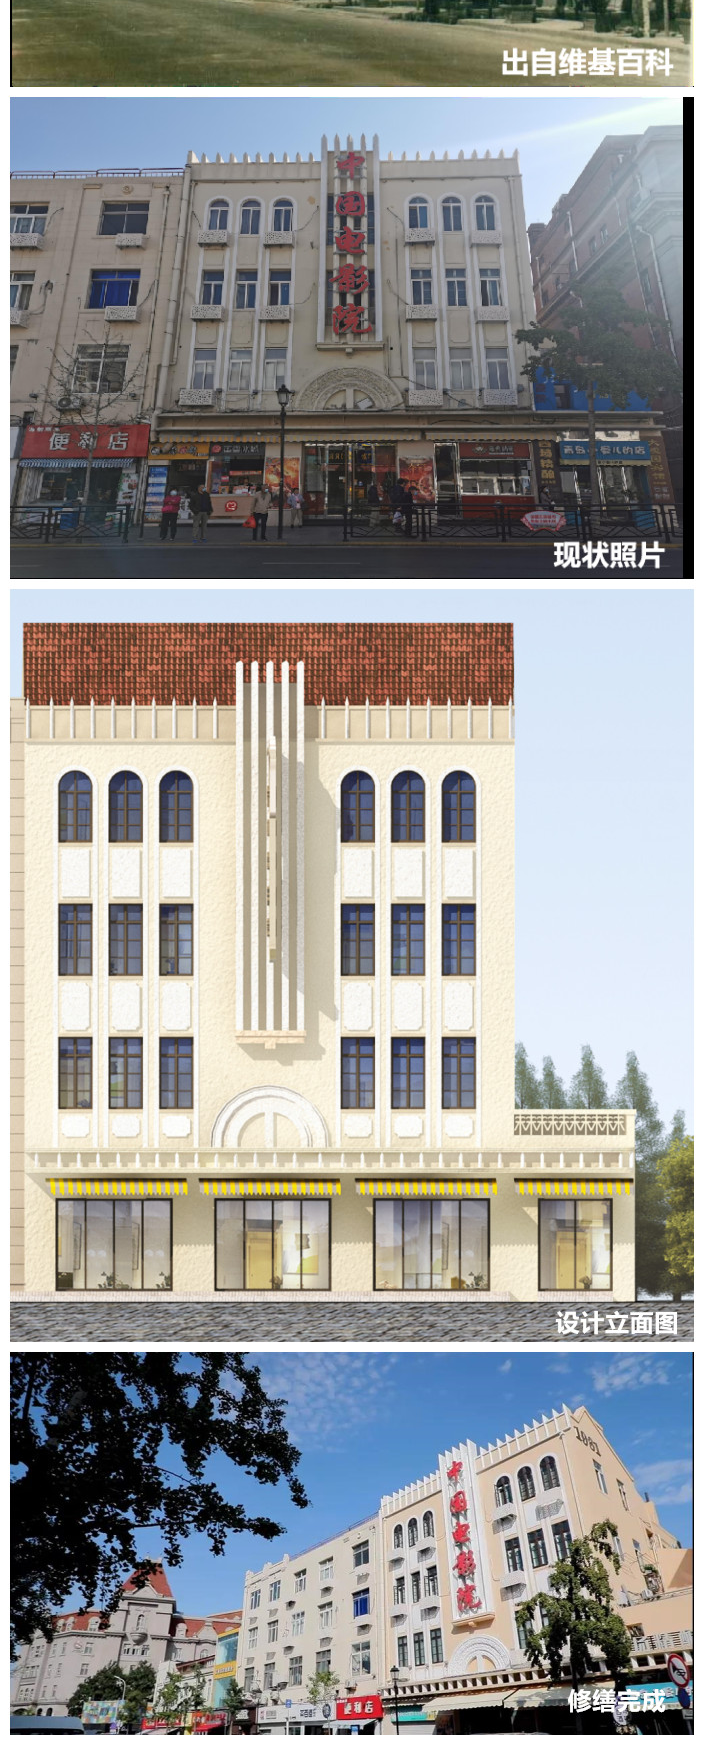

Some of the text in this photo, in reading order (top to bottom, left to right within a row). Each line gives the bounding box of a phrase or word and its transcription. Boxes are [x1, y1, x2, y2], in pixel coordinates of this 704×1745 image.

[329, 152, 374, 335] 中国电影院
[49, 431, 129, 451] 便利店
[447, 1461, 483, 1612] 中国电影院
[344, 1700, 374, 1715] 便利店
